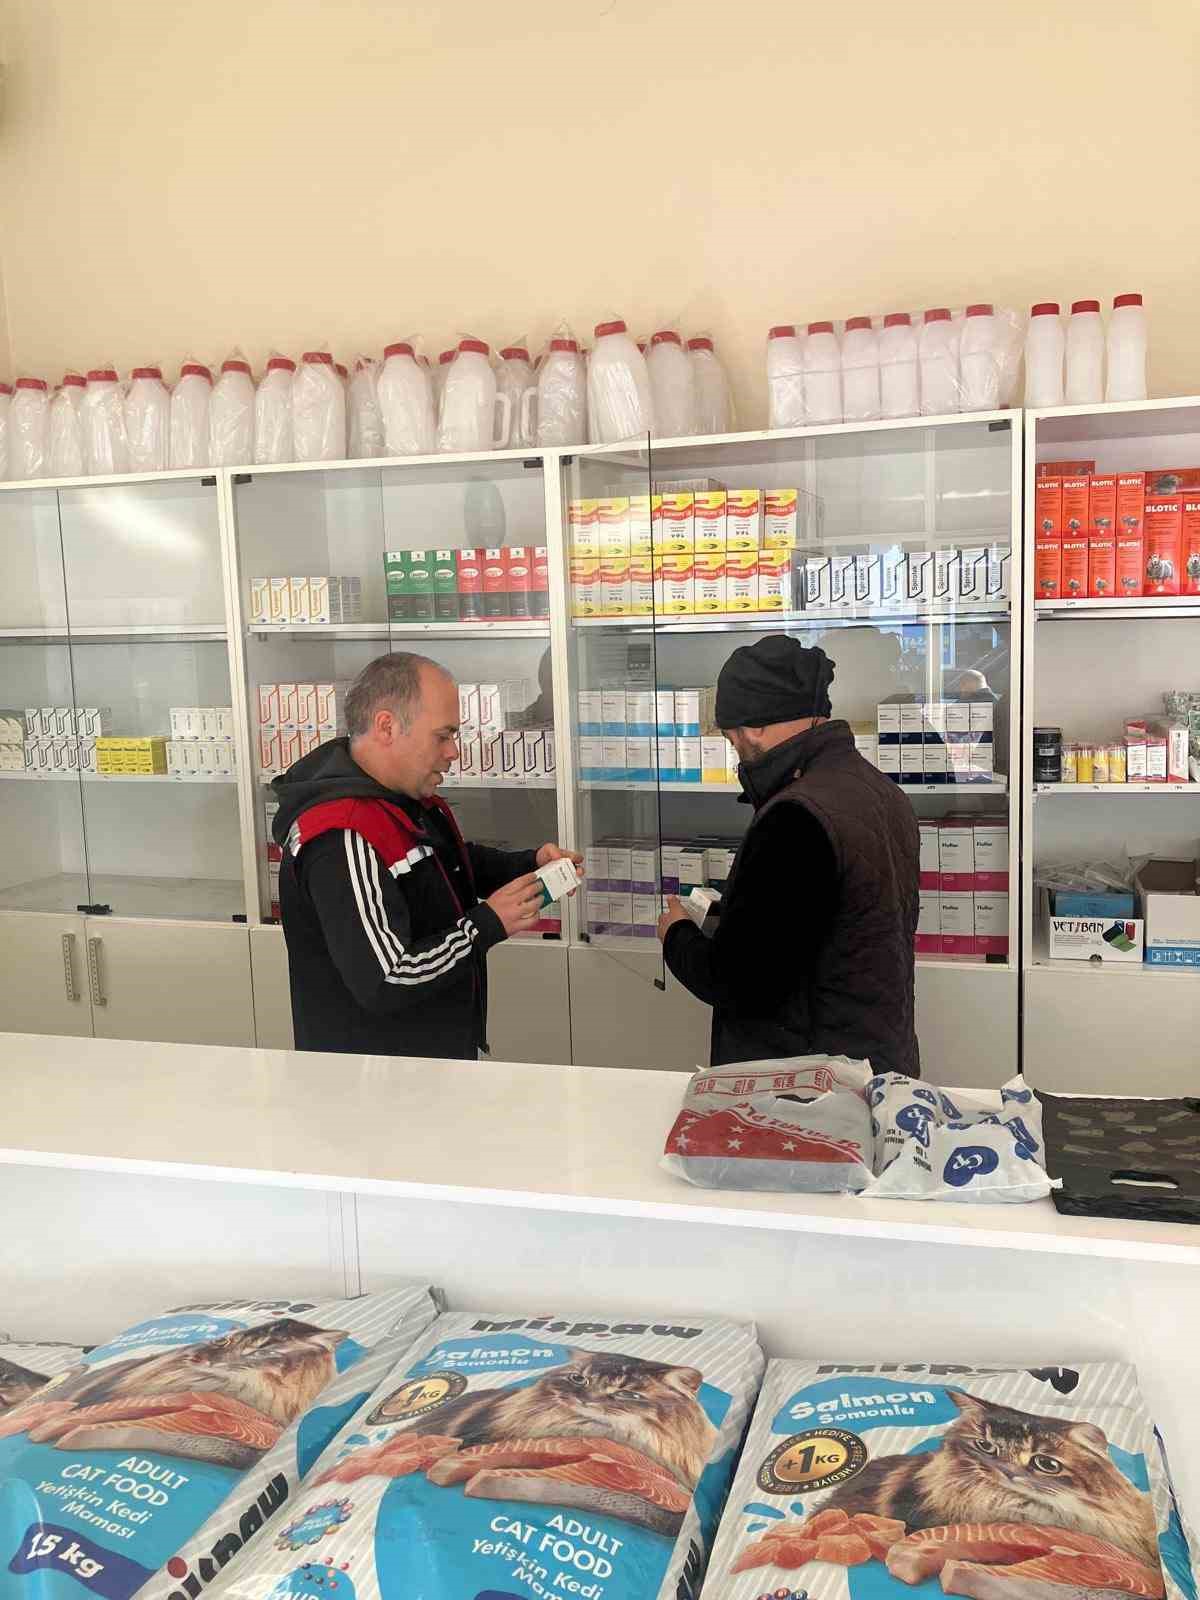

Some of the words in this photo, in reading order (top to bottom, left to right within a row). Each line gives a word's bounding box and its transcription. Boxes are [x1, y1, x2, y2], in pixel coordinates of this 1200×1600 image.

[1146, 503, 1178, 513] BLOTIC
[471, 1316, 703, 1339] mispaw
[425, 1347, 555, 1365] Salmon
[788, 1388, 937, 1420] Salmon
[818, 1405, 916, 1425] Somonlu
[61, 1463, 105, 1482] CAT
[102, 1472, 169, 1507] FOOD
[118, 1456, 189, 1490] ADULT
[34, 1480, 104, 1507] Yetişkin
[105, 1500, 153, 1525] Kedi
[60, 1500, 137, 1540] Maması
[490, 1516, 538, 1545] CAT
[539, 1534, 613, 1579] FOOD
[546, 1514, 624, 1556] ADULT
[58, 1542, 104, 1578] kg
[471, 1538, 549, 1580] Yetişkin
[553, 1572, 604, 1600] Kedi
